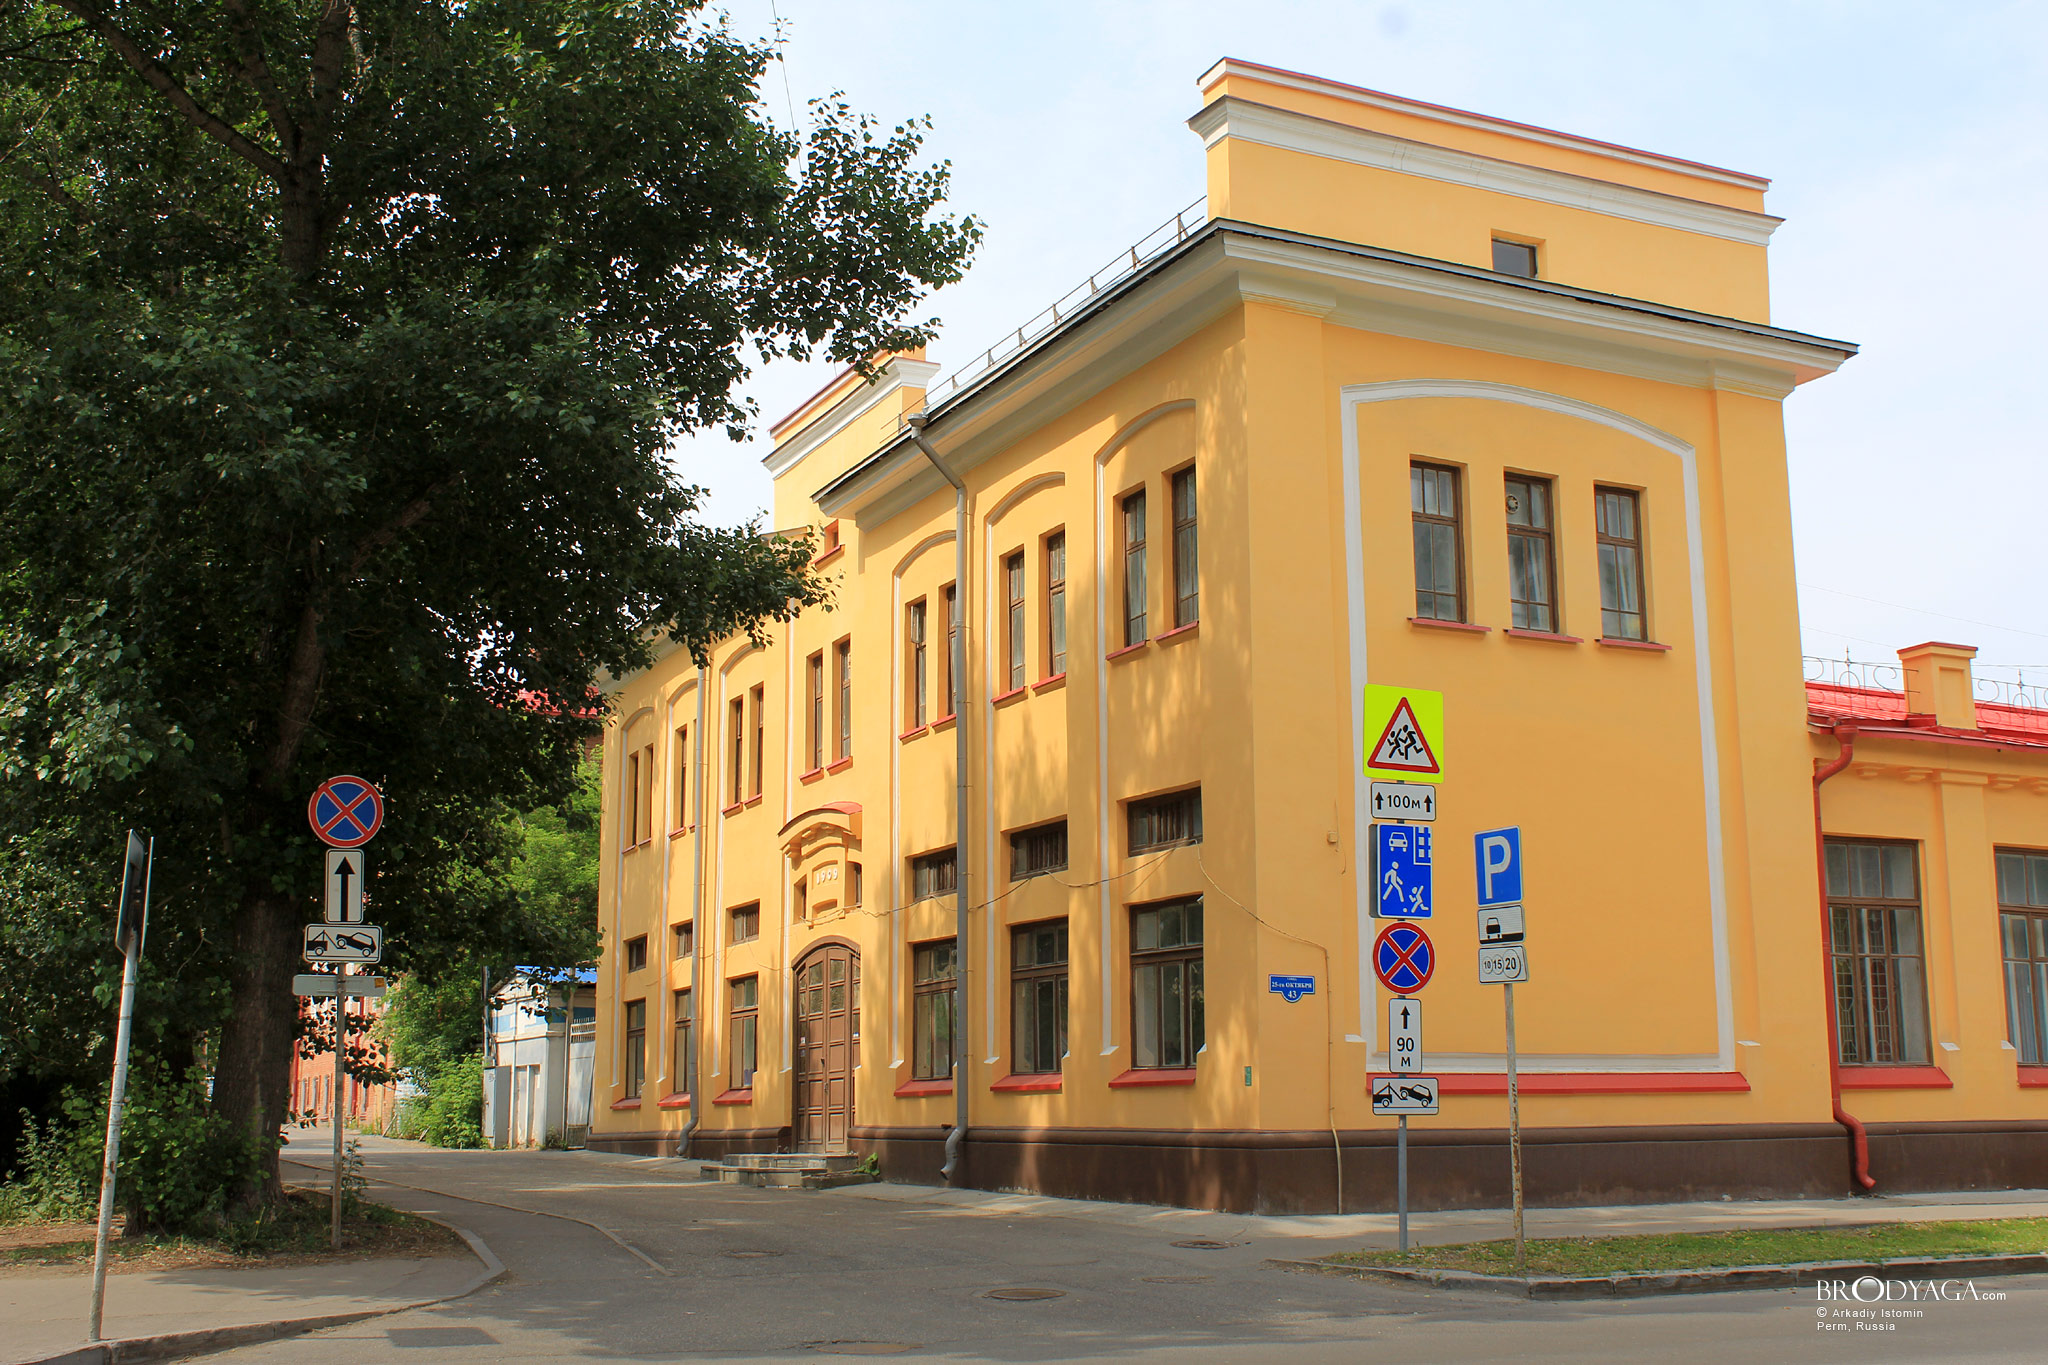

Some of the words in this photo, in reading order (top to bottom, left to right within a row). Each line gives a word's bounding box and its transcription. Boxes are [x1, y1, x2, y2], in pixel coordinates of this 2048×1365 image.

[1482, 835, 1512, 900] P
[1484, 960, 1491, 969] 10
[1493, 959, 1502, 970] 15
[1505, 957, 1517, 970] 20
[1288, 990, 1297, 999] 43
[1396, 1037, 1415, 1052] 90
